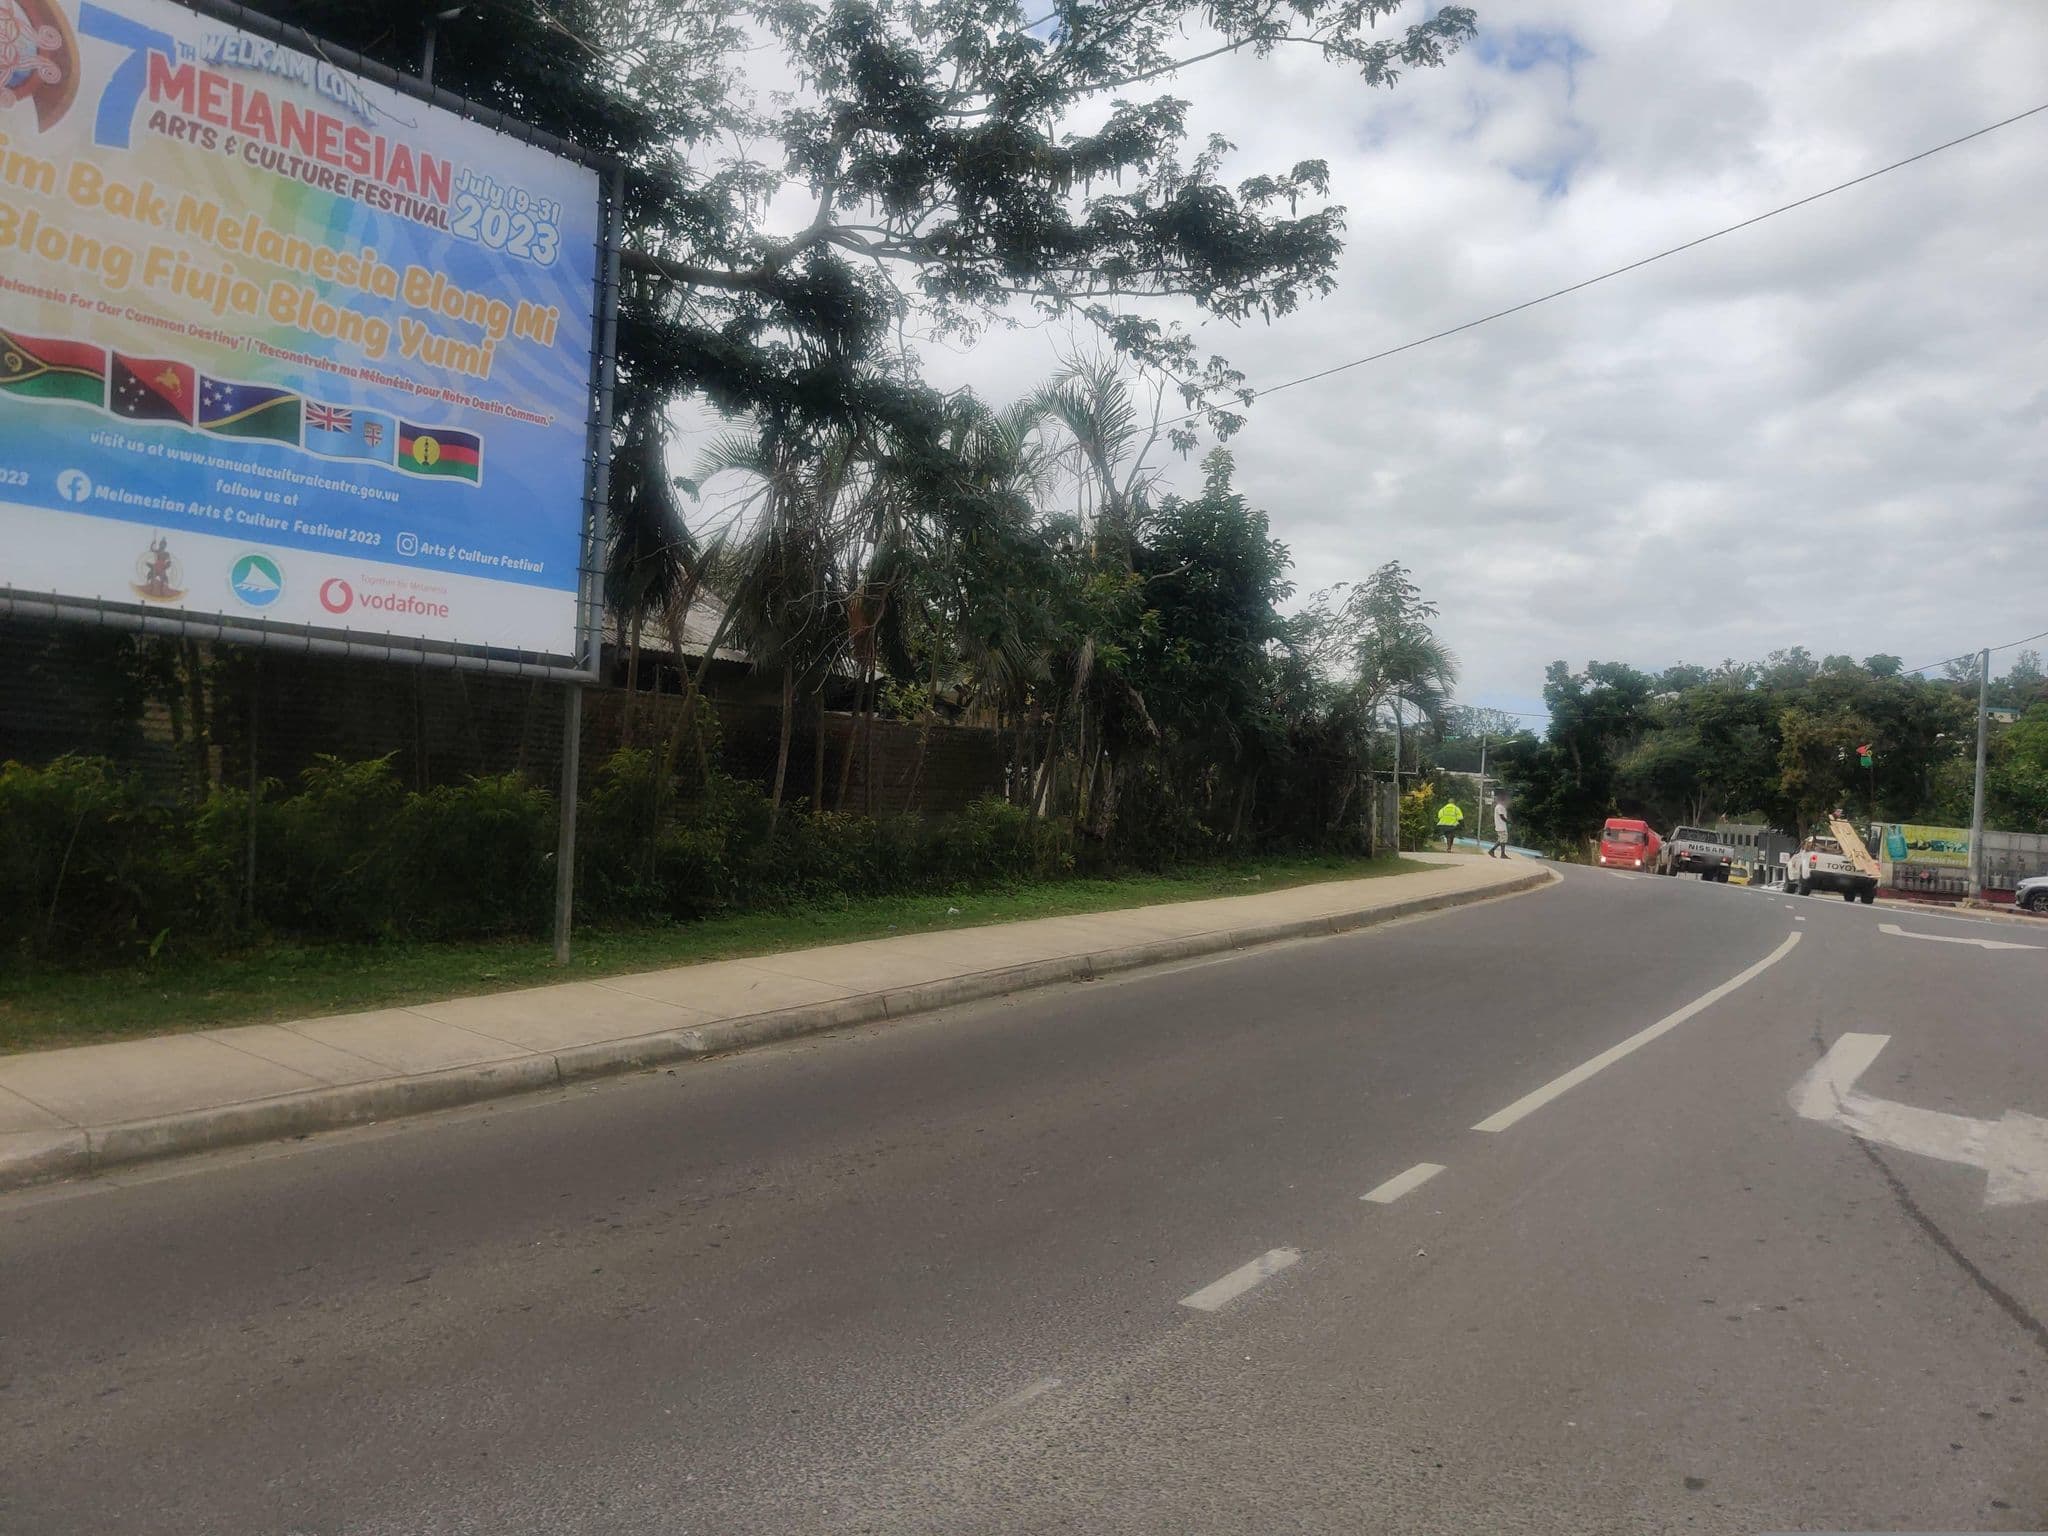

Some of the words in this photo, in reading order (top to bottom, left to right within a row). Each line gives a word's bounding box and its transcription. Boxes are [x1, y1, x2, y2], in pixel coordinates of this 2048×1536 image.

[78, 2, 176, 149] 7
[201, 33, 315, 87] WELKAM
[149, 51, 452, 205] MELANESIAN
[149, 110, 218, 150] ARTS
[243, 141, 347, 196] CULTURE
[351, 180, 449, 231] FESTIVAL
[455, 168, 505, 210] July
[67, 161, 165, 227] Bak
[175, 195, 398, 299] Melanesia
[404, 265, 511, 340] Blong
[514, 302, 559, 346] Mi
[451, 193, 560, 267] 2023
[143, 246, 261, 316] Fiuja
[268, 282, 390, 358] Blong
[69, 292, 93, 310] For
[97, 300, 122, 317] Our
[125, 307, 185, 334] Common
[339, 364, 358, 377] ma
[416, 384, 440, 397] pour
[442, 390, 470, 407] Notre
[472, 397, 503, 415] Destin
[91, 431, 125, 448] visit
[127, 442, 144, 452] us
[148, 444, 163, 457] at
[95, 484, 185, 513] Melanesian
[188, 501, 220, 519] Arts
[236, 509, 289, 531] Culture
[294, 520, 347, 541] Festival
[349, 530, 382, 546] 2023
[216, 479, 261, 500] follow
[264, 491, 280, 503] us
[283, 494, 299, 507] at
[420, 541, 446, 557] Arts
[458, 548, 499, 567] Culture
[501, 555, 544, 574] Festival
[360, 593, 449, 618] vodafone
[1688, 842, 1725, 854] NISSAN
[1826, 862, 1857, 873] TOYOT
